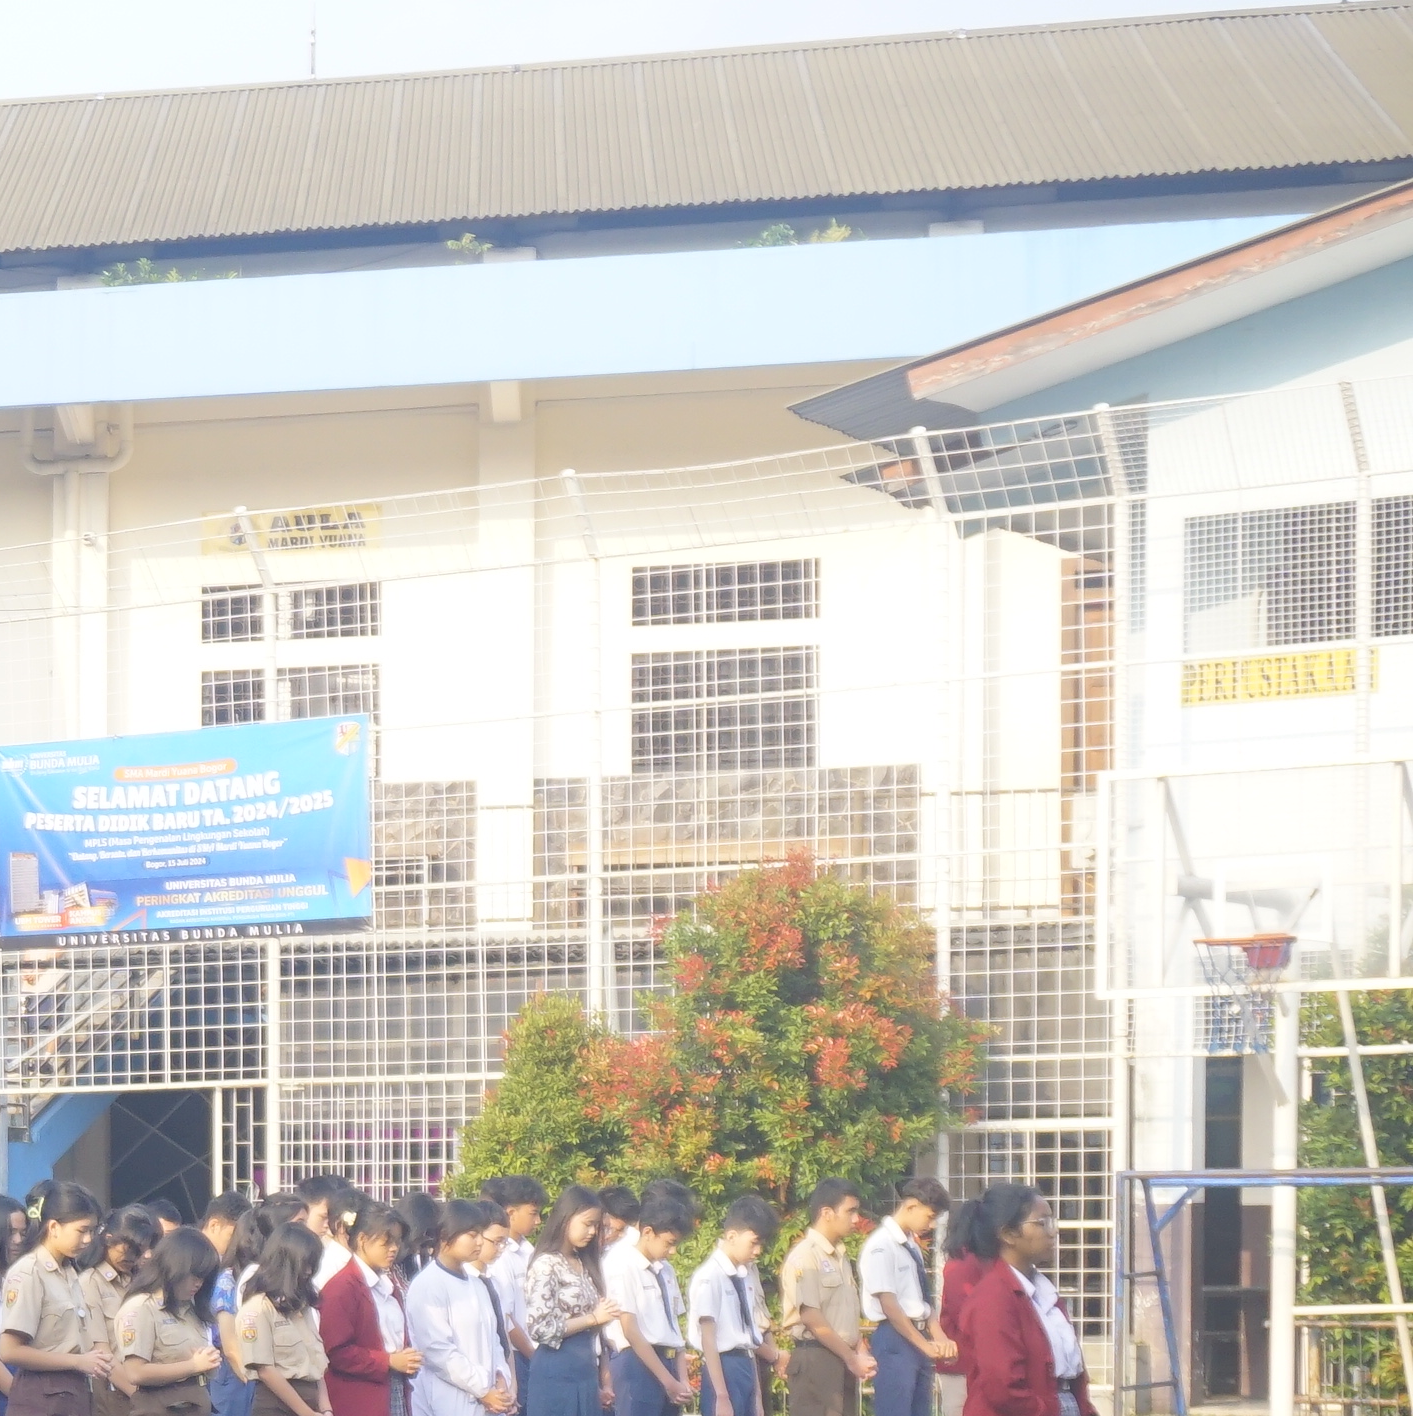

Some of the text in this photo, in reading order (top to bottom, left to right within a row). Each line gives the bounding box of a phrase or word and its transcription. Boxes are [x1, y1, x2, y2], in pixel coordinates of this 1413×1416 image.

[269, 512, 366, 533] AULA
[268, 533, 366, 550] MARDI YUANA
[30, 755, 100, 770] BUNDA MULIA
[124, 763, 227, 778] SMA Mardi Yuana Bogor
[73, 770, 281, 809] SELAMAT DATANG
[24, 789, 334, 832] PESERTA DIDIK BARU TA. 2024/2025
[84, 838, 107, 848] MPLS
[133, 834, 181, 845] Pengenalan
[183, 829, 232, 842] Lingkungan
[233, 826, 270, 838] Sekolah)
[190, 857, 206, 866] 2024
[165, 873, 296, 891] UNIVERSITAS BUNDA MULIA
[136, 884, 329, 907] PERINGKAT AKREDITASI UNGGUL
[156, 908, 199, 919] AKREDITASI
[200, 906, 235, 916] INSTITUSI
[236, 904, 281, 914] PERGURUAN
[283, 902, 309, 911] TINGGI
[34, 915, 62, 925] TOWER
[58, 923, 304, 946] UNIVERSITAS BUNDA MULIA
